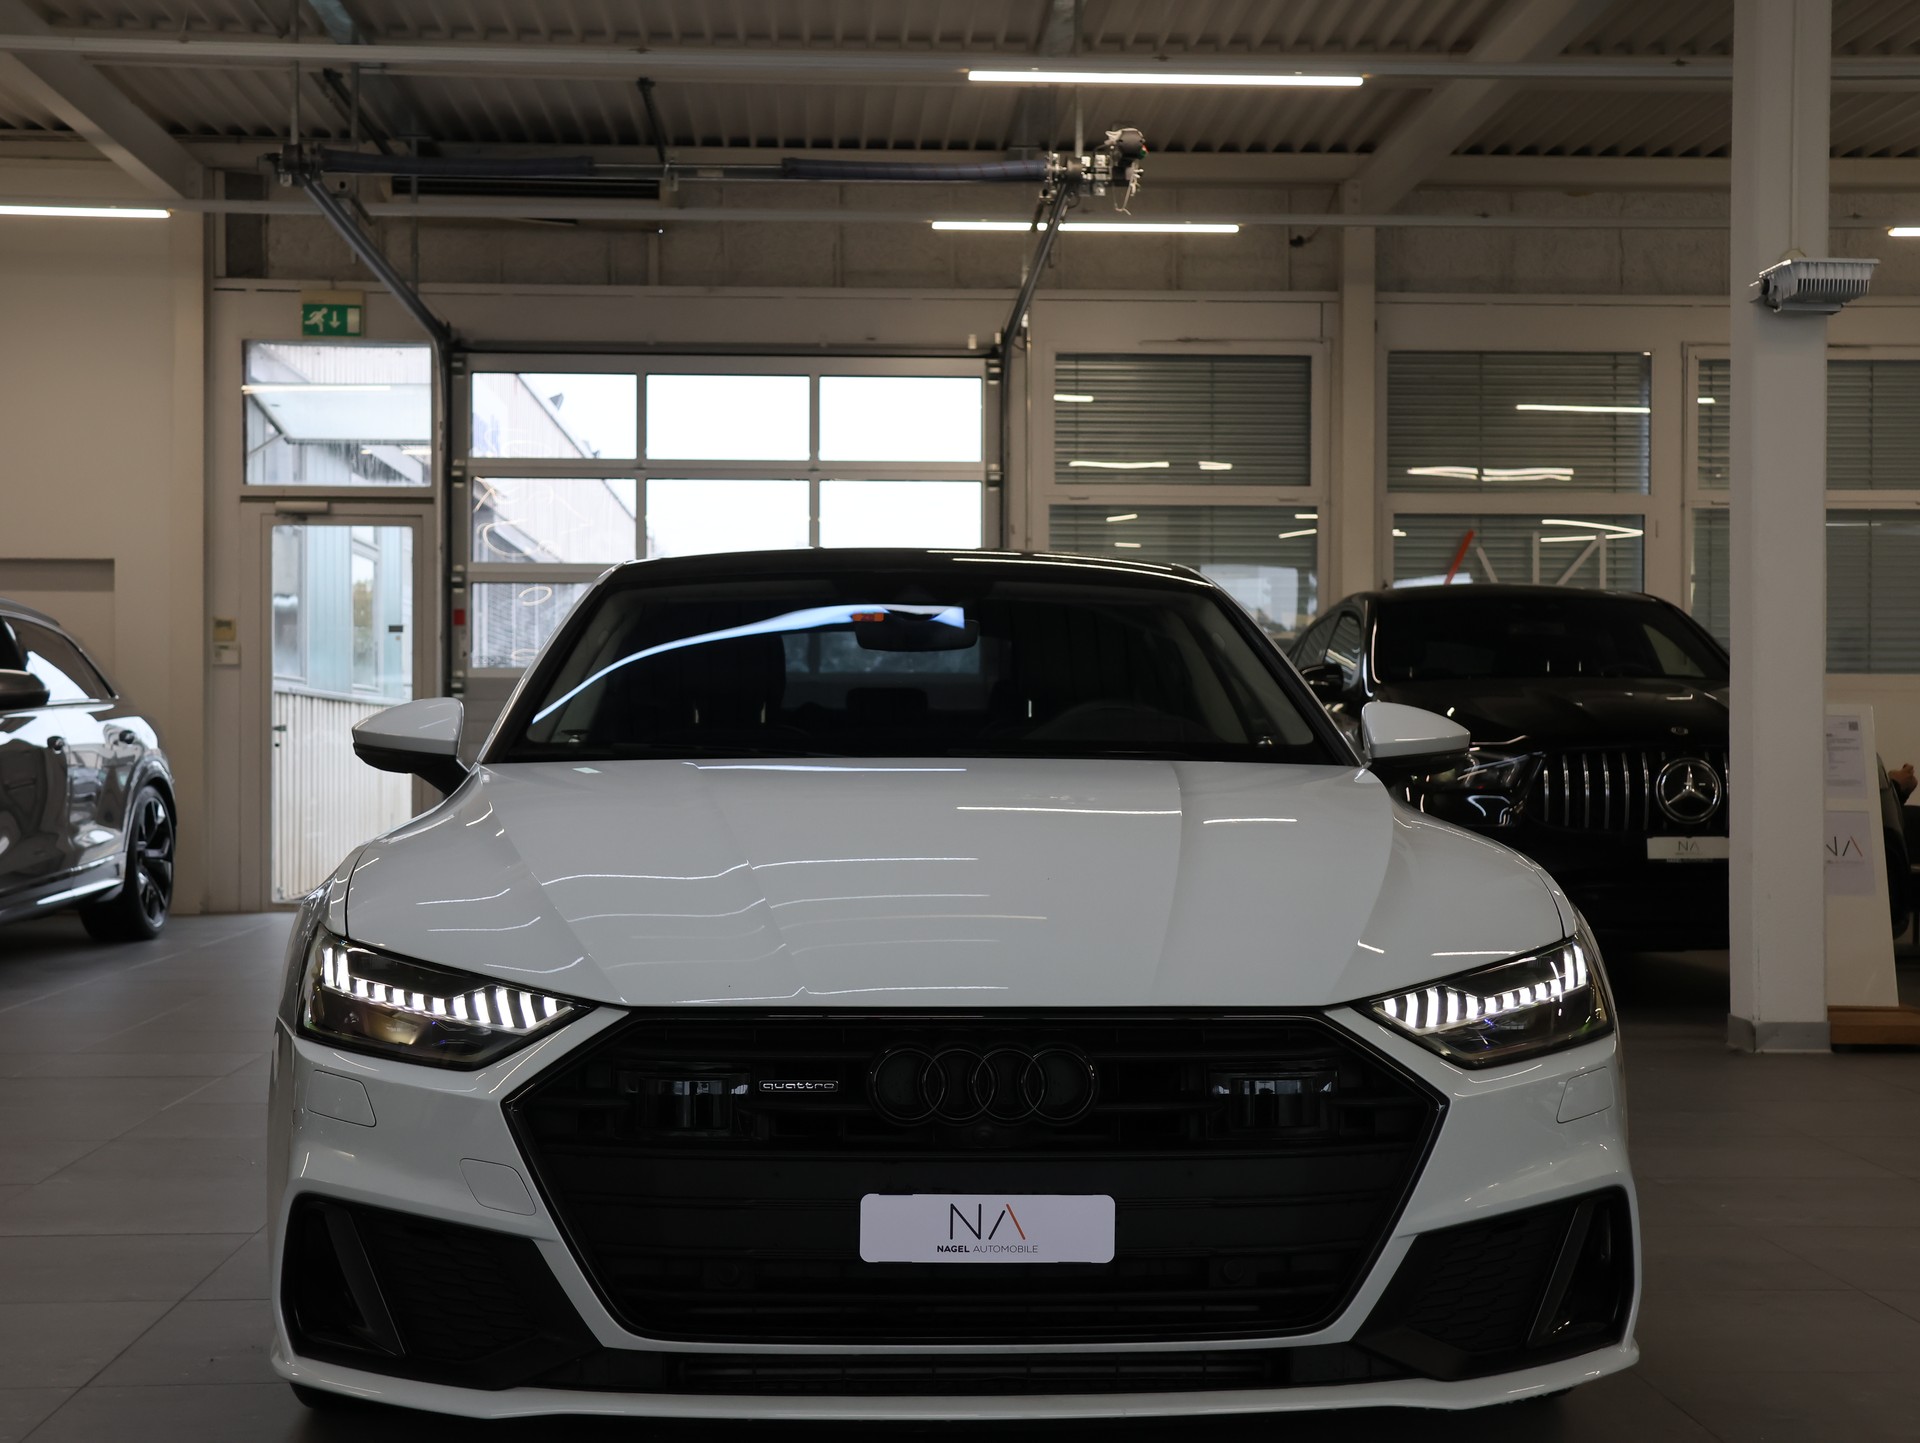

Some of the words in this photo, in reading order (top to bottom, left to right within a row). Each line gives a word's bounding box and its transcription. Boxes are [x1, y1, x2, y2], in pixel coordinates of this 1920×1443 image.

[1678, 840, 1700, 852] NA
[762, 1082, 835, 1090] quattro
[949, 1203, 1026, 1241] NA
[936, 1245, 970, 1253] NAGEL
[972, 1245, 1039, 1253] AUTOMOBILE
